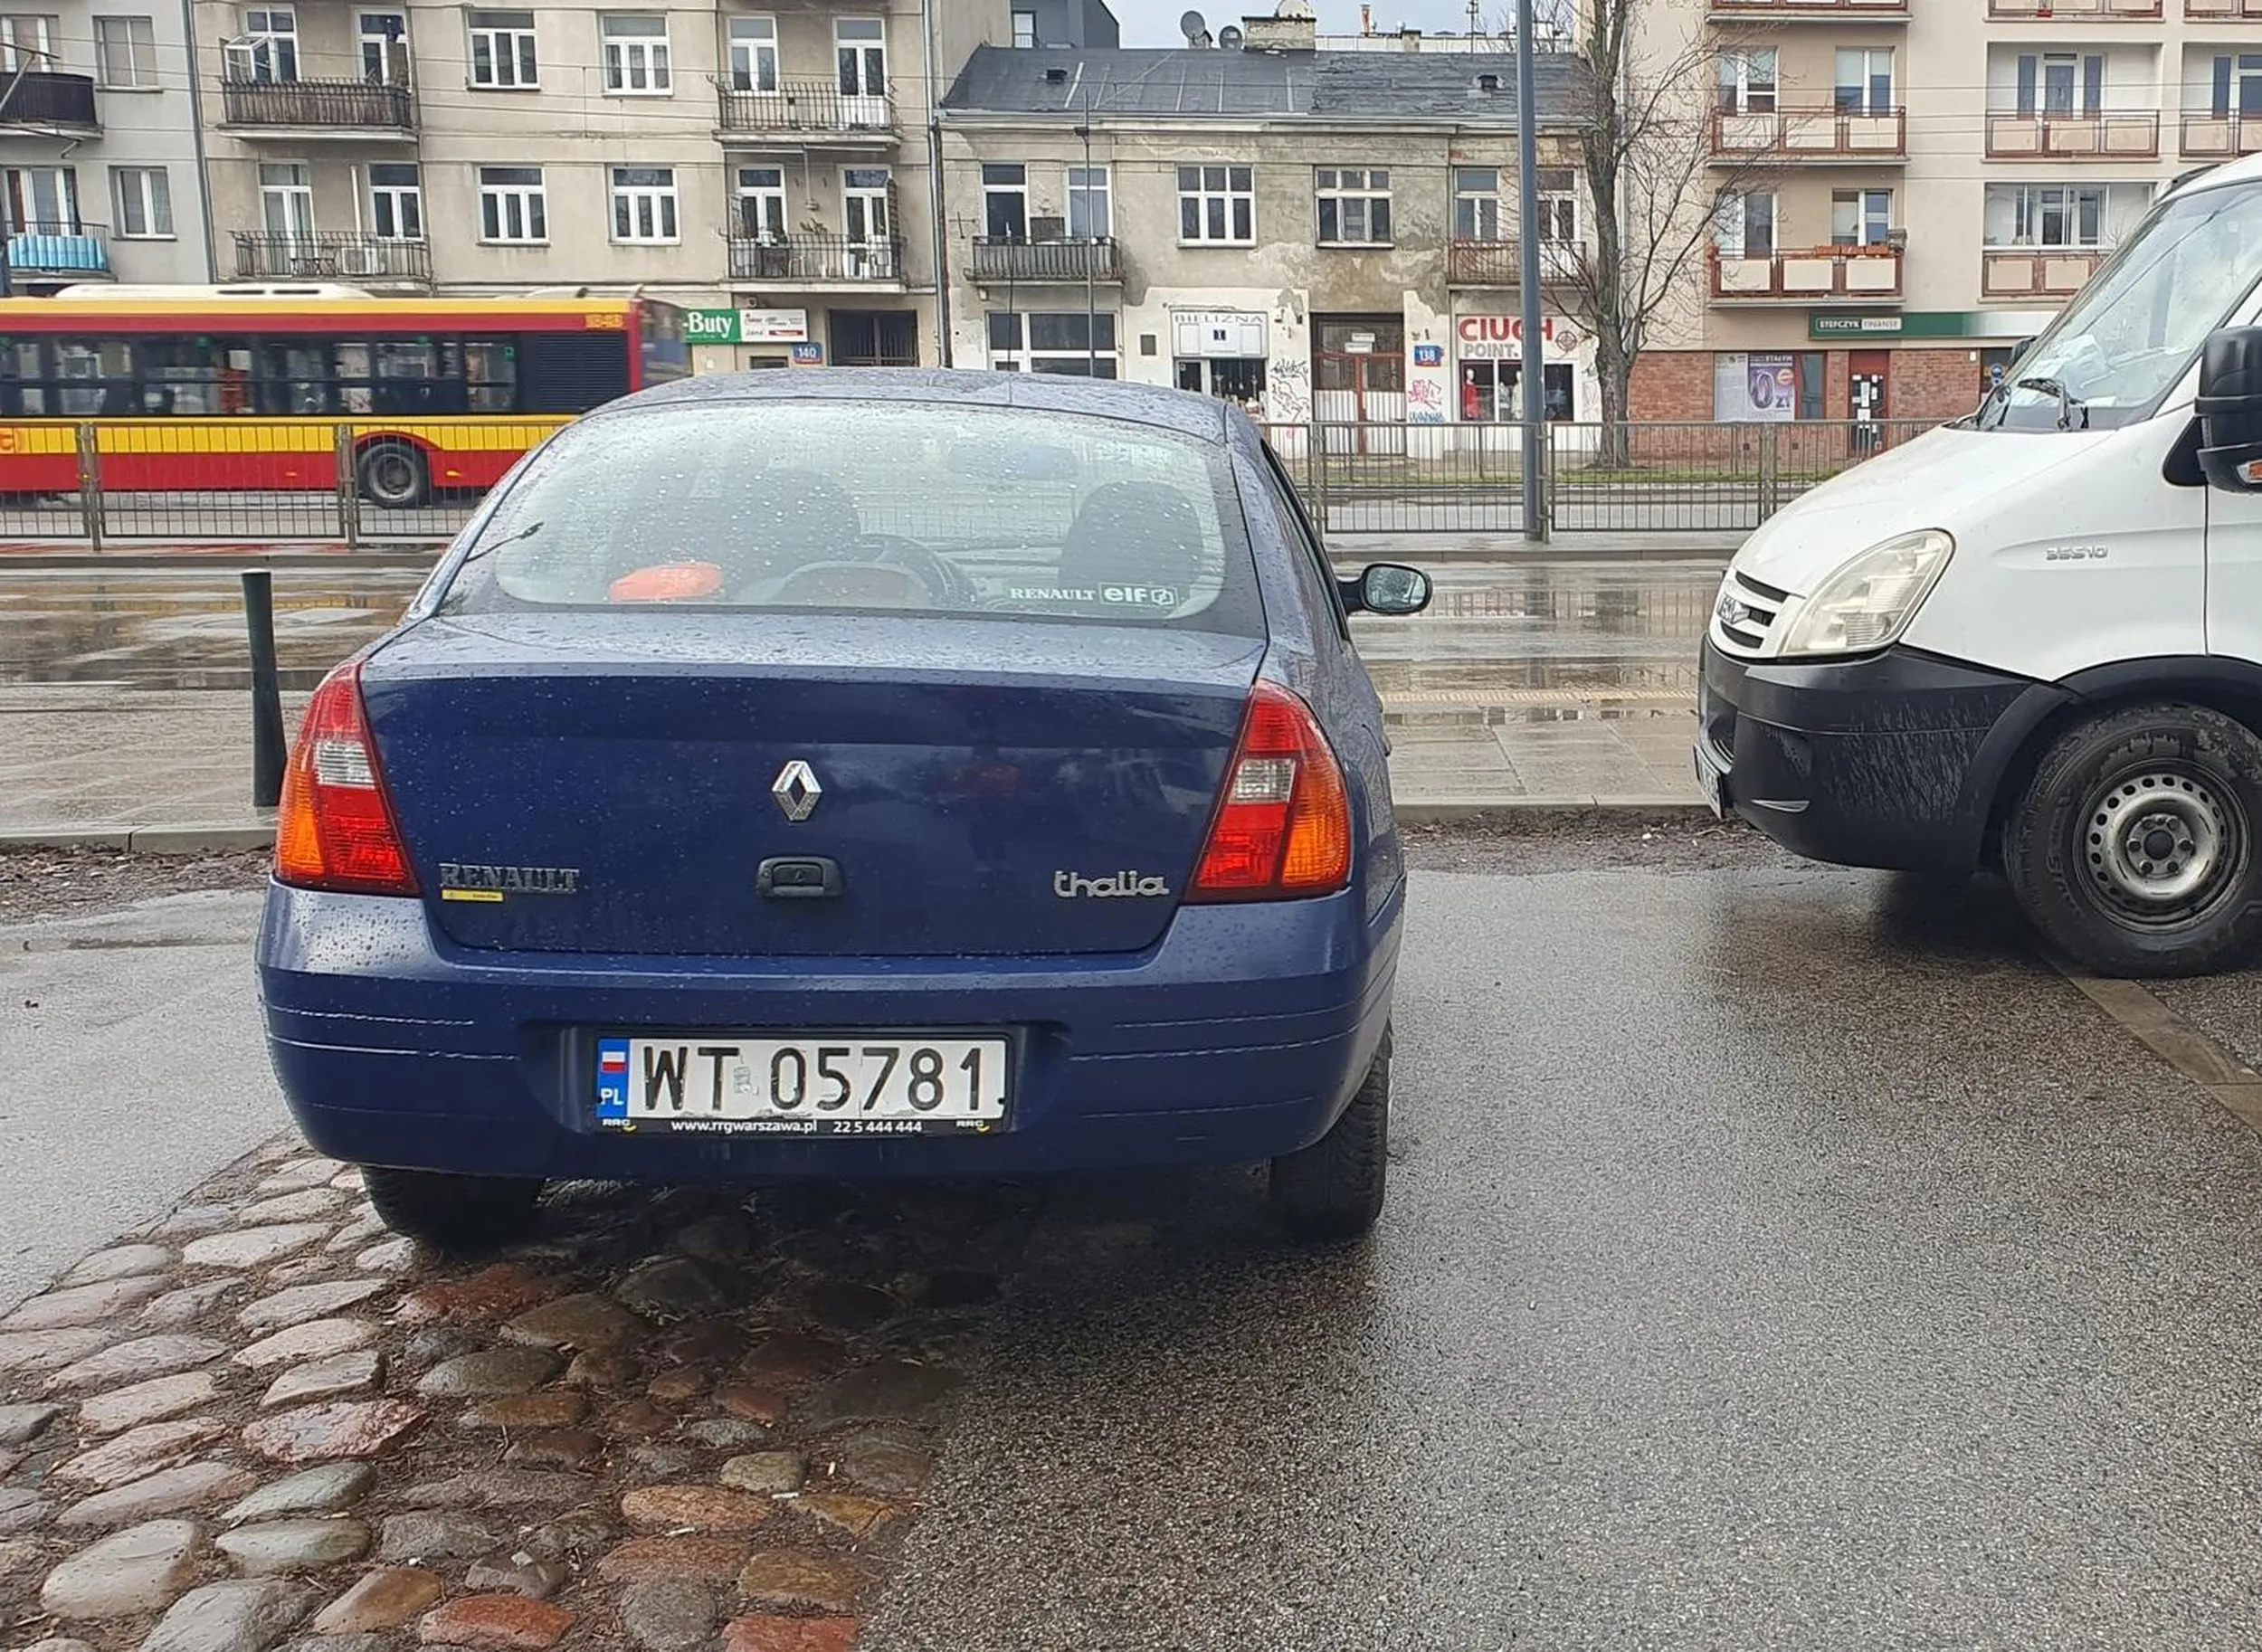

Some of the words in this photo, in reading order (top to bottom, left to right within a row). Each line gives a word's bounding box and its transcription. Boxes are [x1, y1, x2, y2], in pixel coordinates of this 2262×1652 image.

[1174, 314, 1263, 323] BIELIZNA
[1819, 319, 1861, 329] STEFCZYK
[797, 347, 817, 358] 140
[1419, 349, 1436, 361] 138
[1010, 587, 1096, 601] RENAULT
[1103, 586, 1148, 603] elf
[439, 862, 580, 893] RENAULT
[1053, 869, 1170, 897] thalia
[643, 1046, 740, 1111] WT
[770, 1047, 982, 1111] 05781
[600, 1087, 625, 1106] PL
[670, 1119, 818, 1135] www.rrgwarszawa.pl
